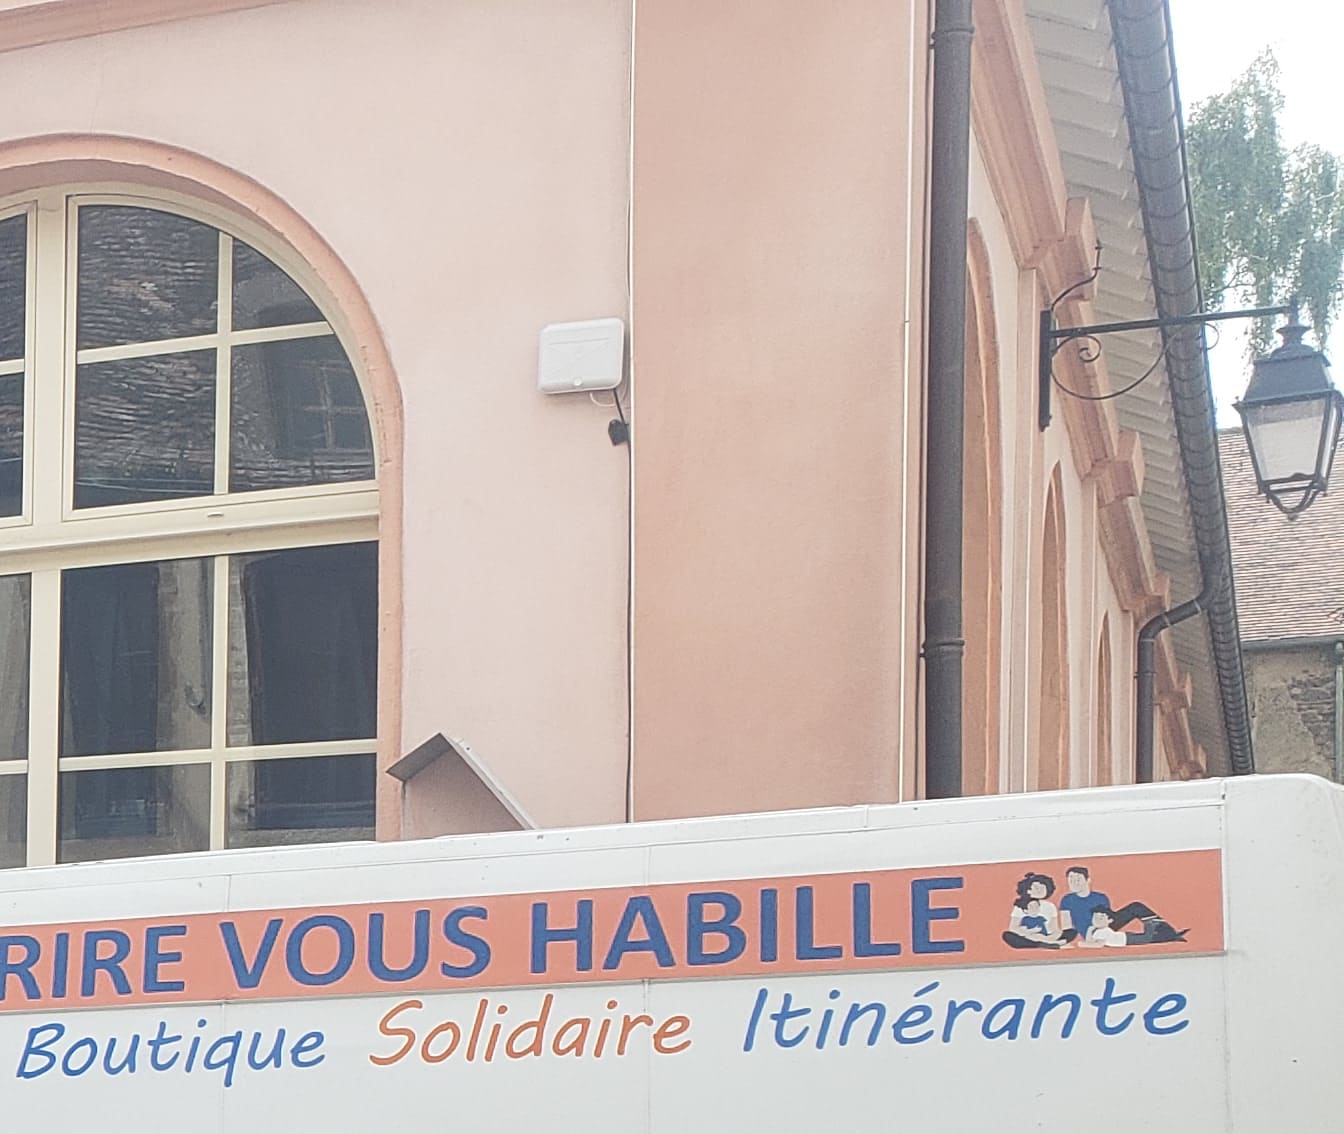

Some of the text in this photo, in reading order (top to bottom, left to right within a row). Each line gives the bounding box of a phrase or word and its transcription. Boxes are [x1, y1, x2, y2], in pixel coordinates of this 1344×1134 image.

[220, 906, 492, 991] VOUS
[529, 876, 967, 974] HABILLE
[15, 977, 1191, 1088] Boutique Solidaire Itinérante
